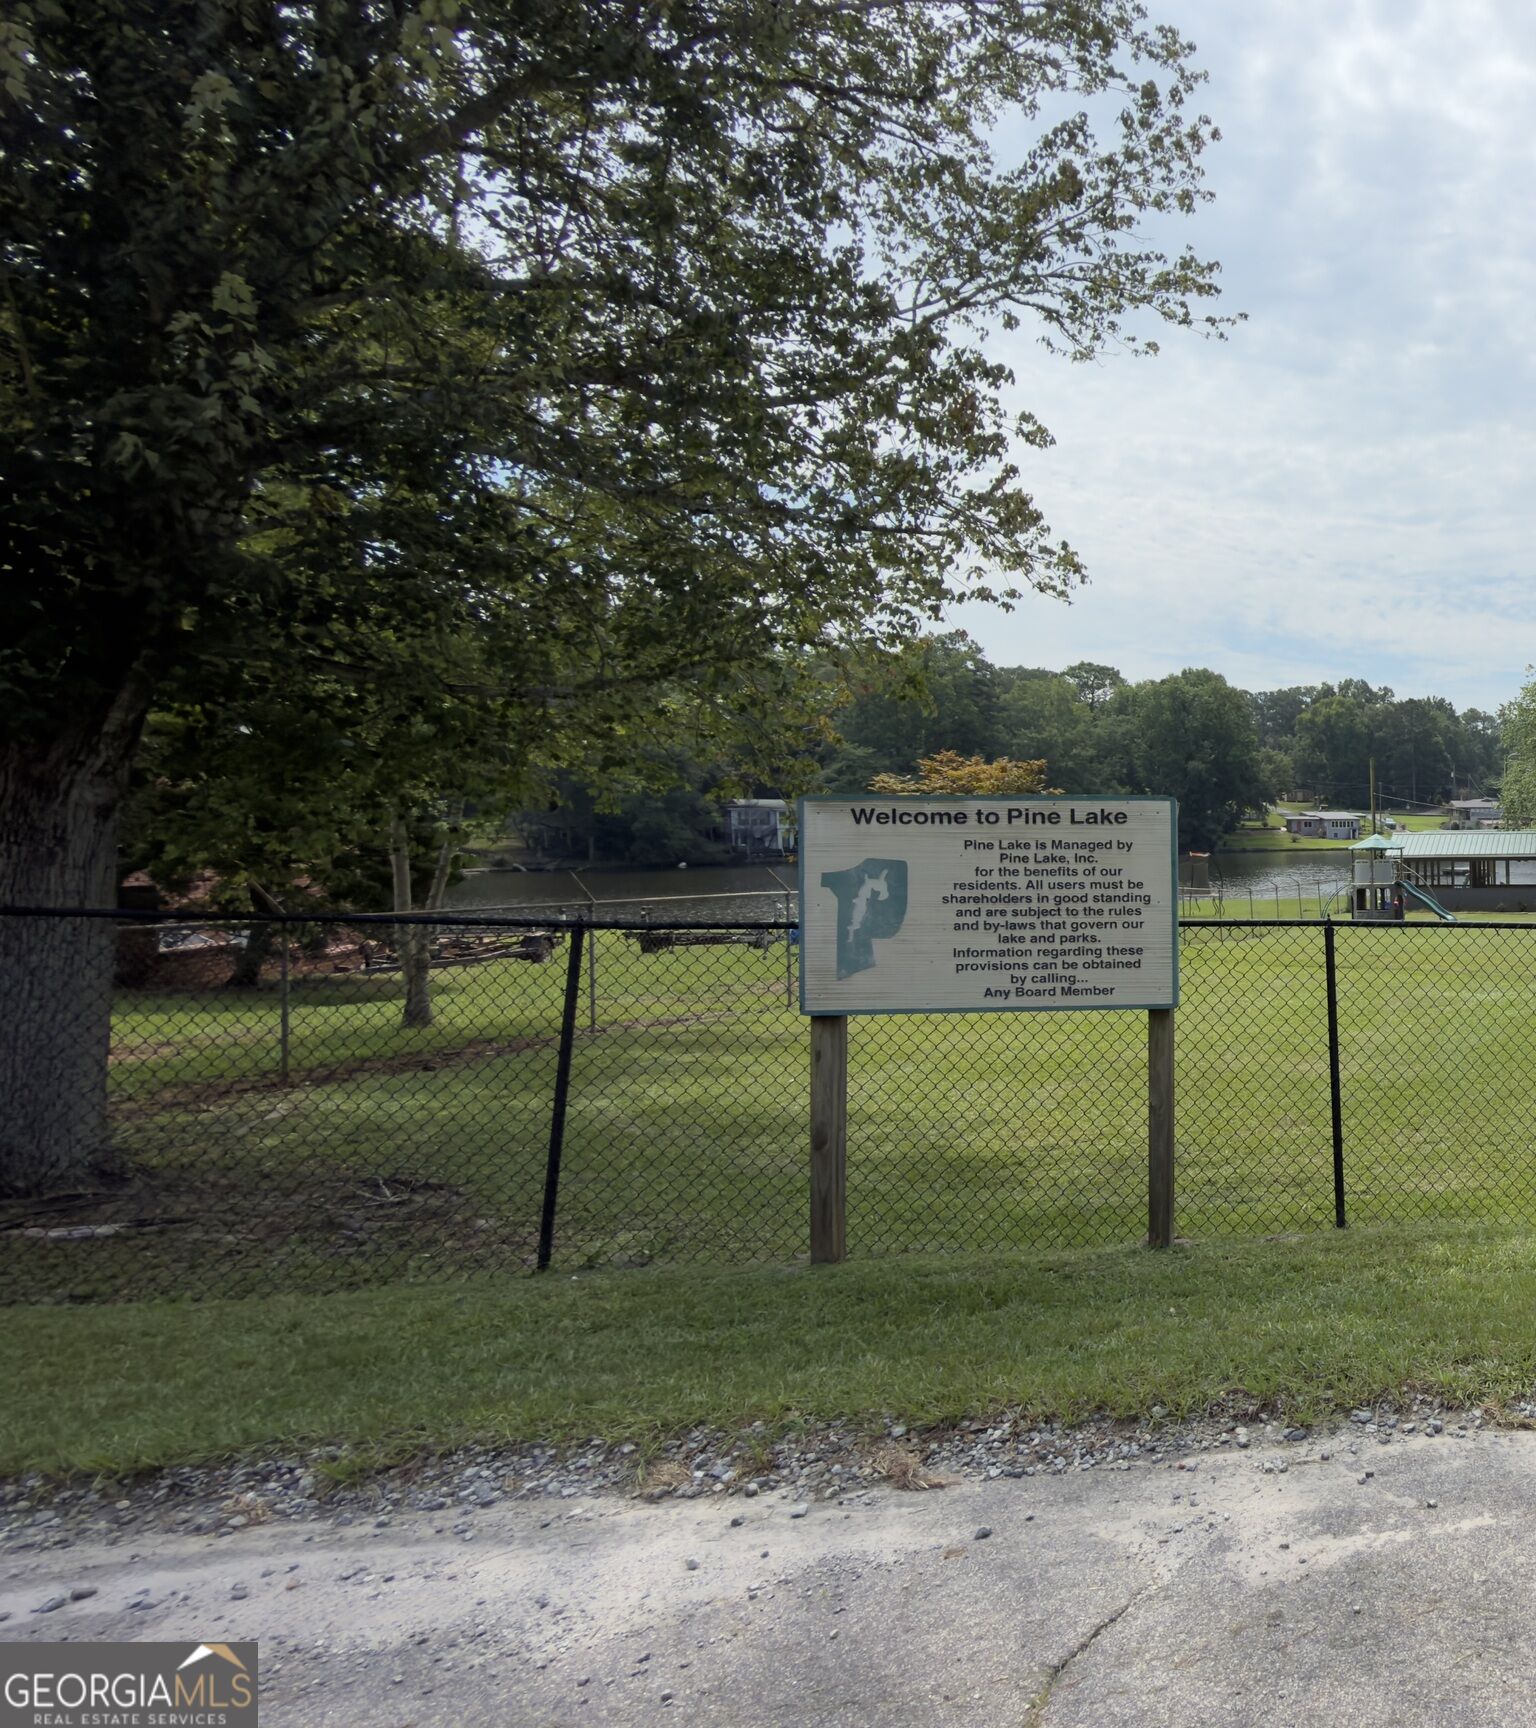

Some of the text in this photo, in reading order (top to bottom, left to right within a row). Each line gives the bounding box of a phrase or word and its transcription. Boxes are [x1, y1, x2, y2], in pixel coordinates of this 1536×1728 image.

[851, 808, 1128, 825] Welcome to Pine Lake
[964, 839, 1133, 854] Pine Lake is Managed by
[1000, 853, 1098, 865] Pine Lake, Inc.
[974, 866, 1122, 877] for the benefits of our
[953, 880, 1144, 890] residents. All users must be
[942, 892, 1151, 906] shareholders in good standing
[956, 906, 1142, 920] and are subject to the rules
[953, 919, 1144, 933] and by-laws that govern our
[998, 933, 1101, 946] lake and parks.
[953, 946, 1143, 960] Information regarding these
[956, 958, 1141, 973] provisions can be obtained
[1011, 972, 1088, 986] by calling...
[984, 986, 1115, 1000] Any Board Member
